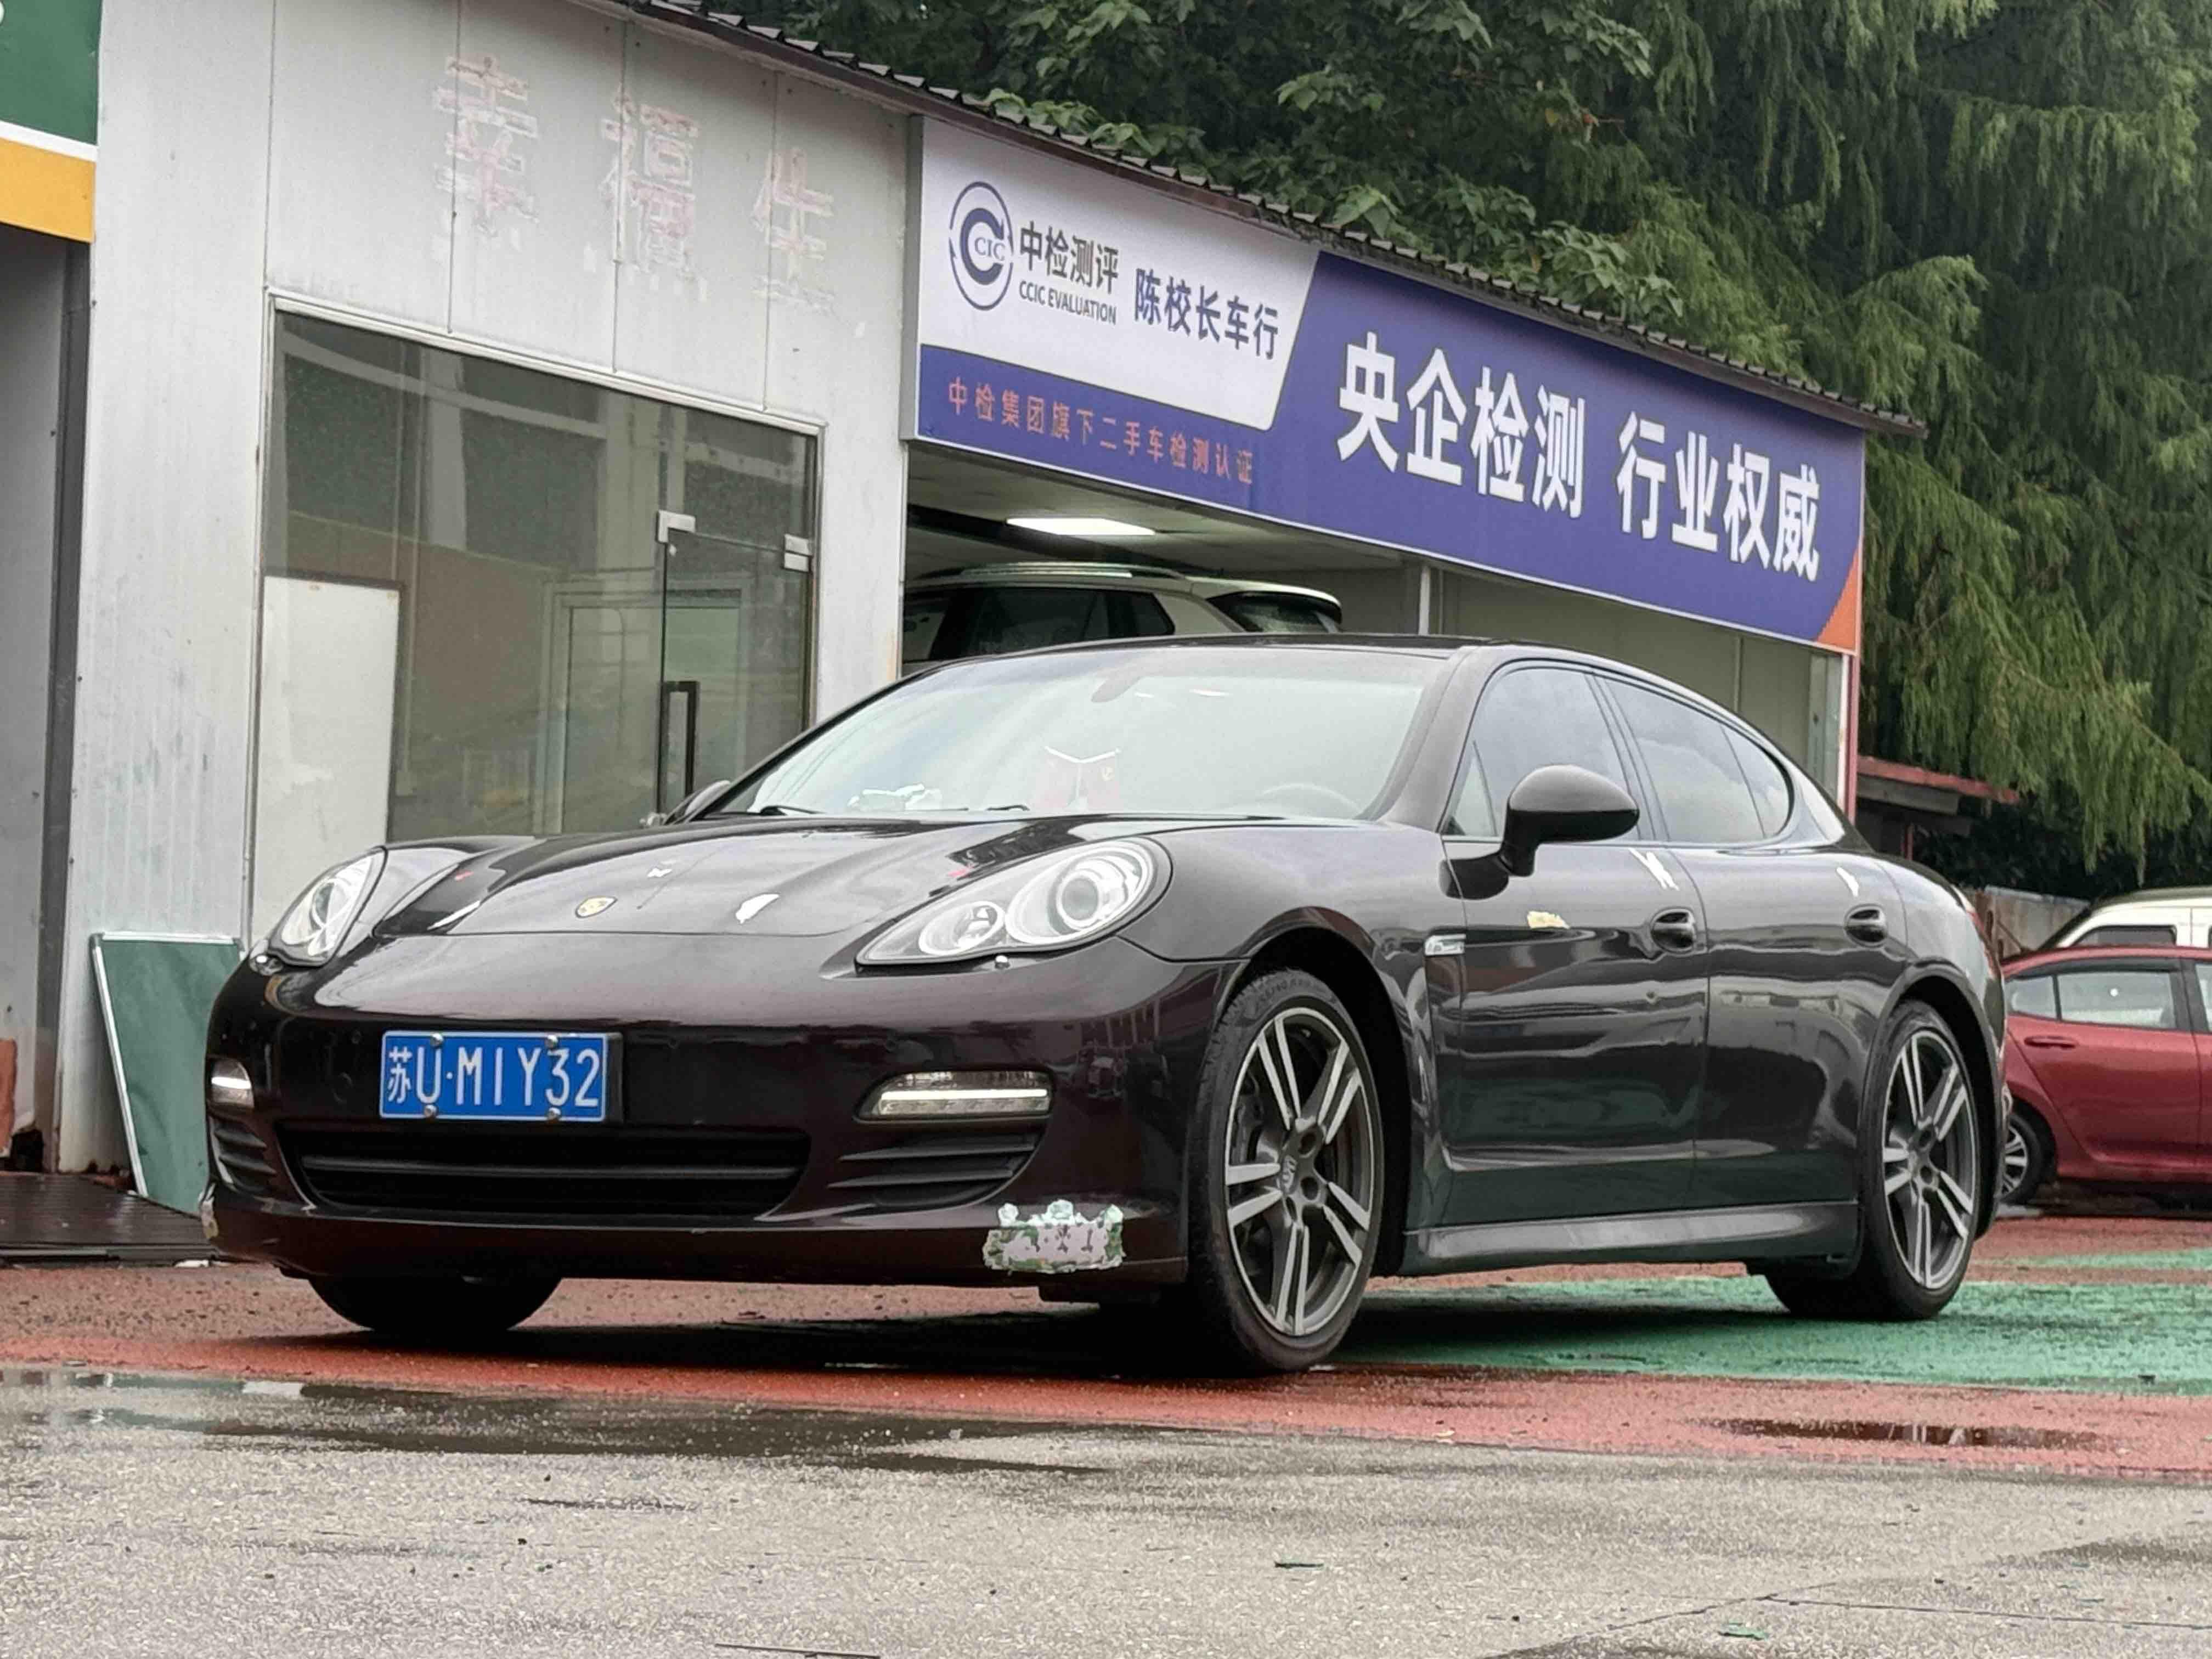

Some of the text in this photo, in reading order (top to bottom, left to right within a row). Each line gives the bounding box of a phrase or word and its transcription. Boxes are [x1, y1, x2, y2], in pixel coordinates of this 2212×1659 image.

[1019, 221, 1119, 294] 中检测评
[1019, 280, 1117, 325] CCIC EVALUATION
[1134, 268, 1279, 360] 陈校长车行
[948, 377, 1253, 484] 中检集团旗下二手车检测认证
[1337, 331, 1820, 582] 央企检测 行业权威
